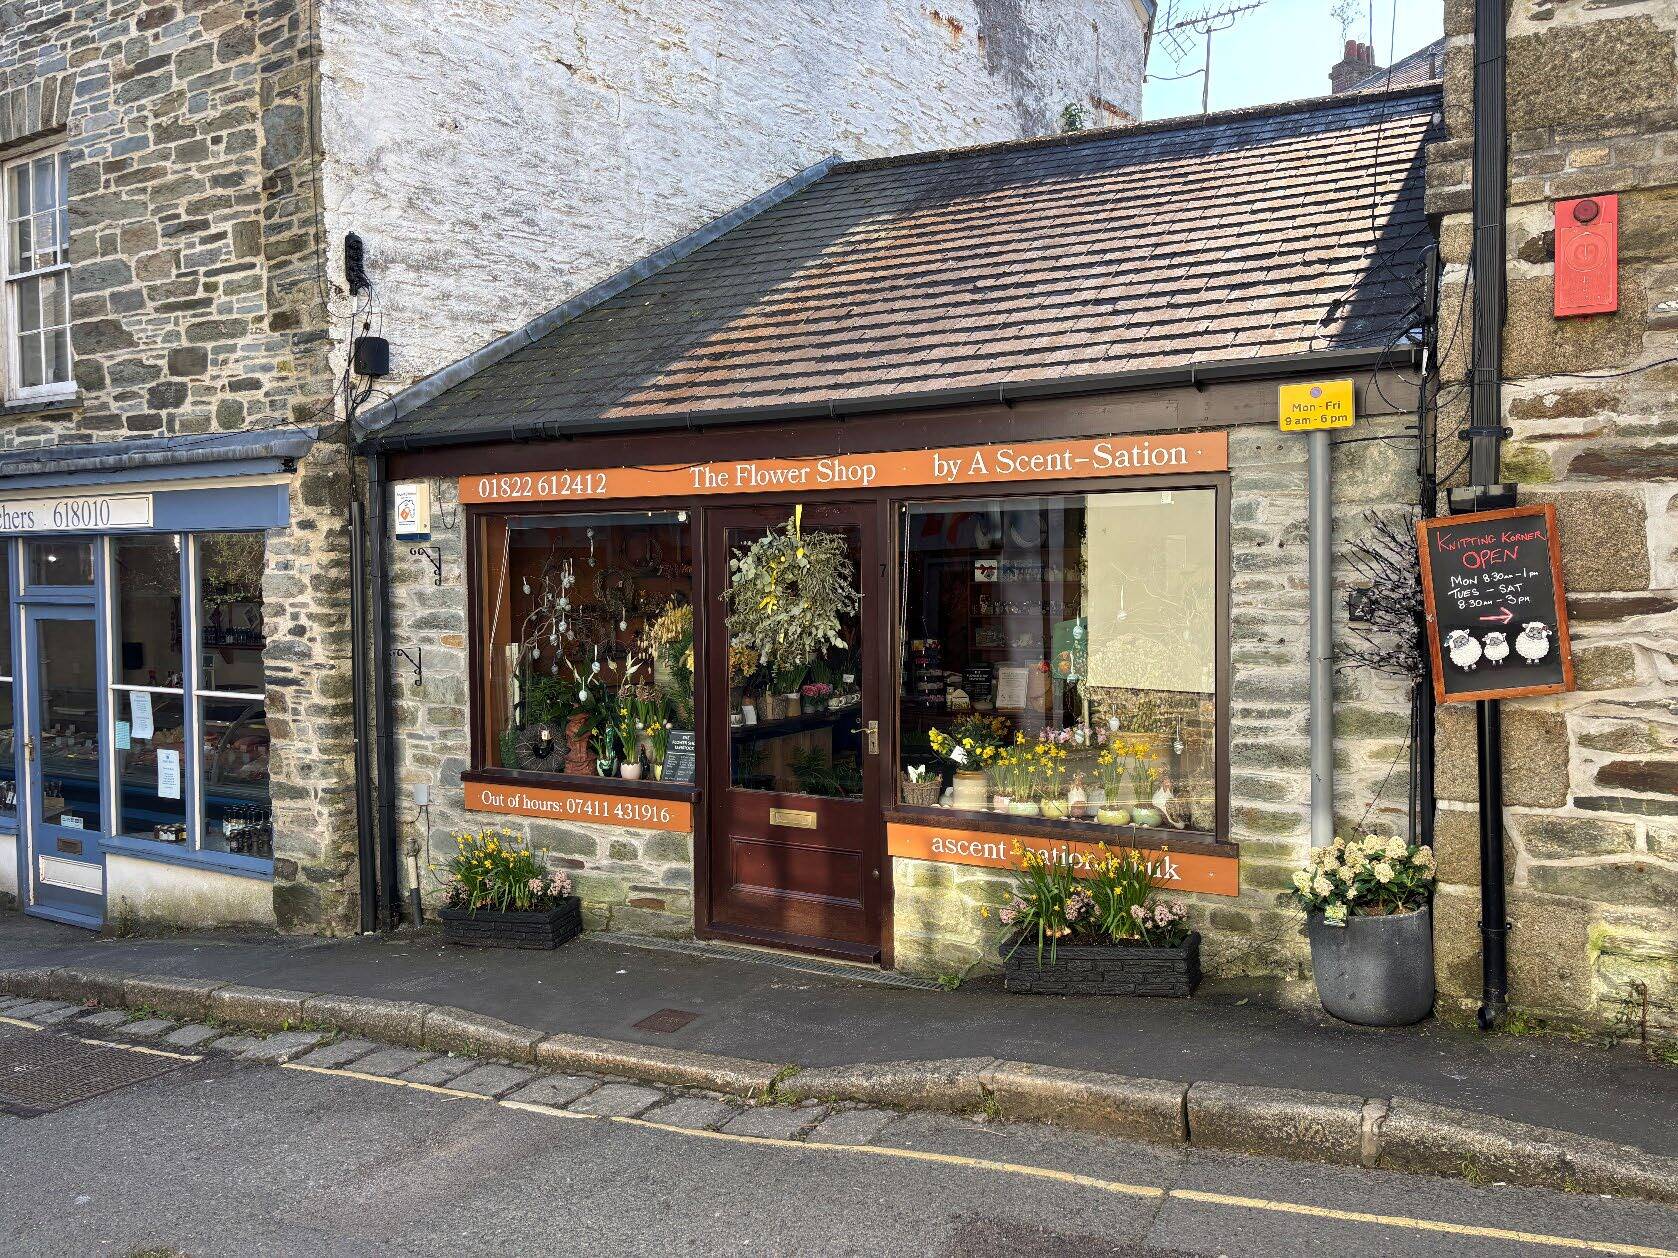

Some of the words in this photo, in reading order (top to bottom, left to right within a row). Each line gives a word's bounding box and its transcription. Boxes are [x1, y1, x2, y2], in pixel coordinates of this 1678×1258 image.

[1292, 403, 1316, 412] Mon
[1325, 401, 1341, 410] Fri
[1285, 417, 1292, 425] 9
[1294, 417, 1311, 425] am
[1320, 414, 1327, 423] 6
[1330, 414, 1347, 423] pm
[933, 453, 962, 481] by
[968, 453, 989, 475] A
[995, 441, 1188, 474] Scent-Sation
[690, 466, 729, 488] The
[735, 463, 810, 487] Flower
[816, 459, 876, 486] Shop
[479, 477, 532, 497] 01822
[537, 473, 606, 496] 612412
[0, 504, 35, 529] hers
[53, 500, 110, 527] 618010
[1501, 530, 1547, 543] KORNER
[1462, 545, 1519, 569] OPEN
[879, 563, 887, 577] 7
[1447, 588, 1480, 599] TUES
[1498, 583, 1523, 593] SAT
[1450, 575, 1478, 587] MON
[481, 790, 505, 807] Out
[508, 793, 522, 808] of
[523, 796, 563, 813] hours:
[566, 798, 610, 817] 07411
[614, 802, 670, 823] 431916
